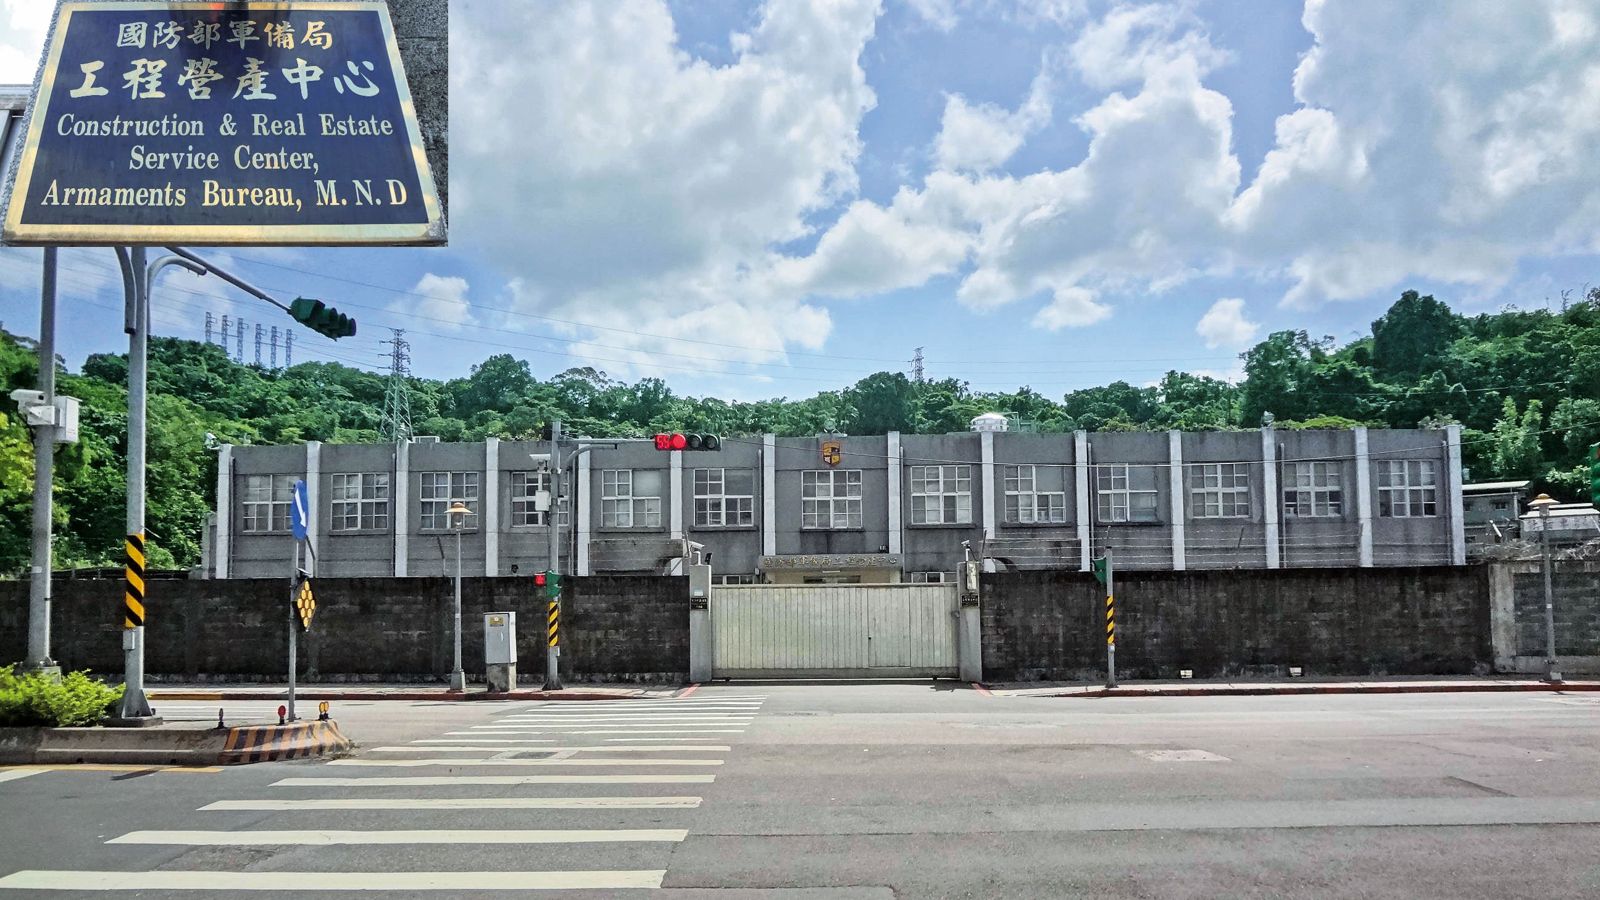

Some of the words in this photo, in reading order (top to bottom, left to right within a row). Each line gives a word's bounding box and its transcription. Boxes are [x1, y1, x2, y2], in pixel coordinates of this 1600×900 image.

[116, 20, 333, 50] 國防部軍備局
[70, 57, 381, 101] 工程營產中心
[57, 113, 205, 137] Construction
[219, 114, 237, 136] &
[252, 113, 306, 136] Real
[320, 114, 393, 136] Estate
[129, 145, 219, 170] Service
[234, 145, 319, 174] Center,
[41, 179, 186, 207] Armaments
[202, 180, 302, 212] Bureau,
